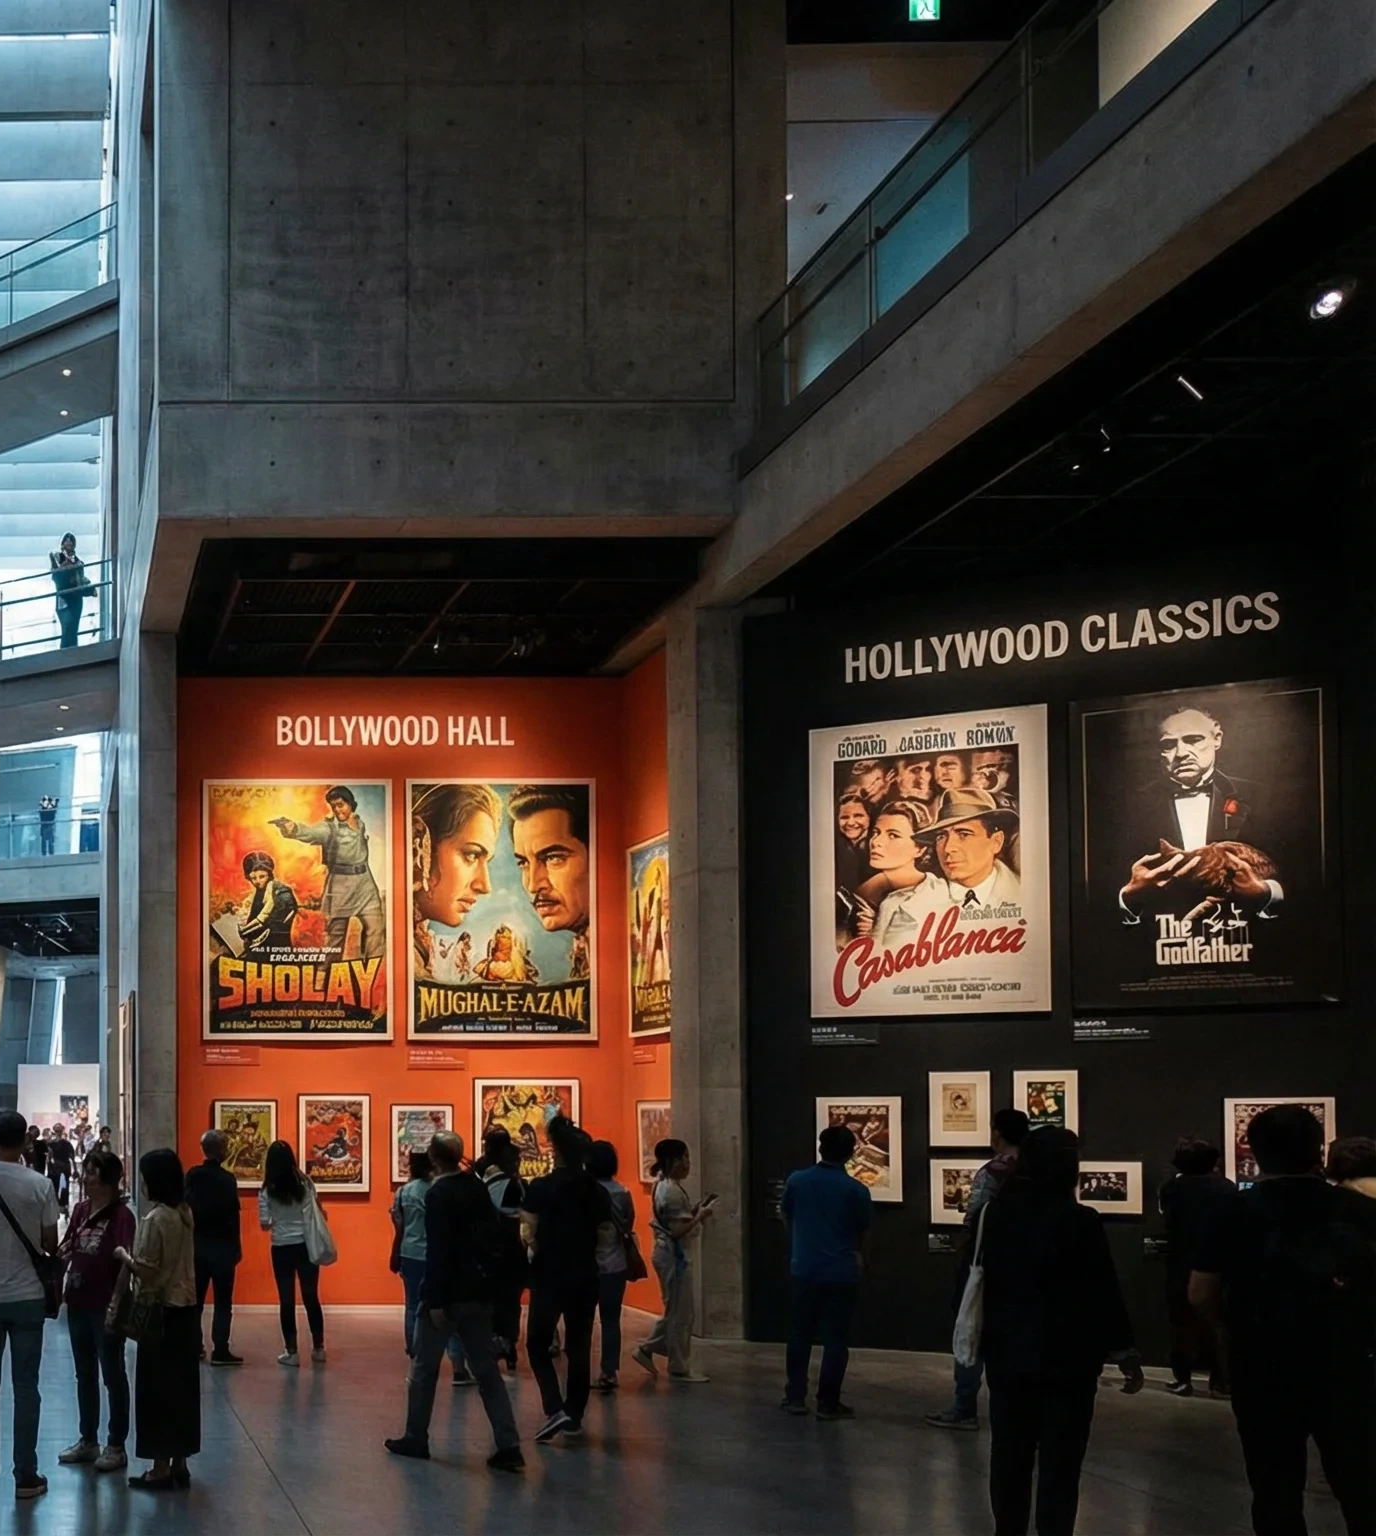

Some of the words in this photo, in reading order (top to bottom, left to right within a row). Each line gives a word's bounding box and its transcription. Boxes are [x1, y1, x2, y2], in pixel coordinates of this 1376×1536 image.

[844, 620, 1070, 684] HOLLYWOOD
[1080, 590, 1282, 654] CLASSICS
[276, 715, 440, 747] BOLLYWOOD
[447, 715, 515, 747] HALL
[837, 739, 887, 759] GODARD
[1155, 914, 1193, 940] The
[833, 905, 1028, 1008] Casablanca
[1156, 936, 1253, 966] Godfather
[218, 955, 383, 1011] SHOLAY
[418, 985, 588, 1024] MUGHAL-E-AZAM
